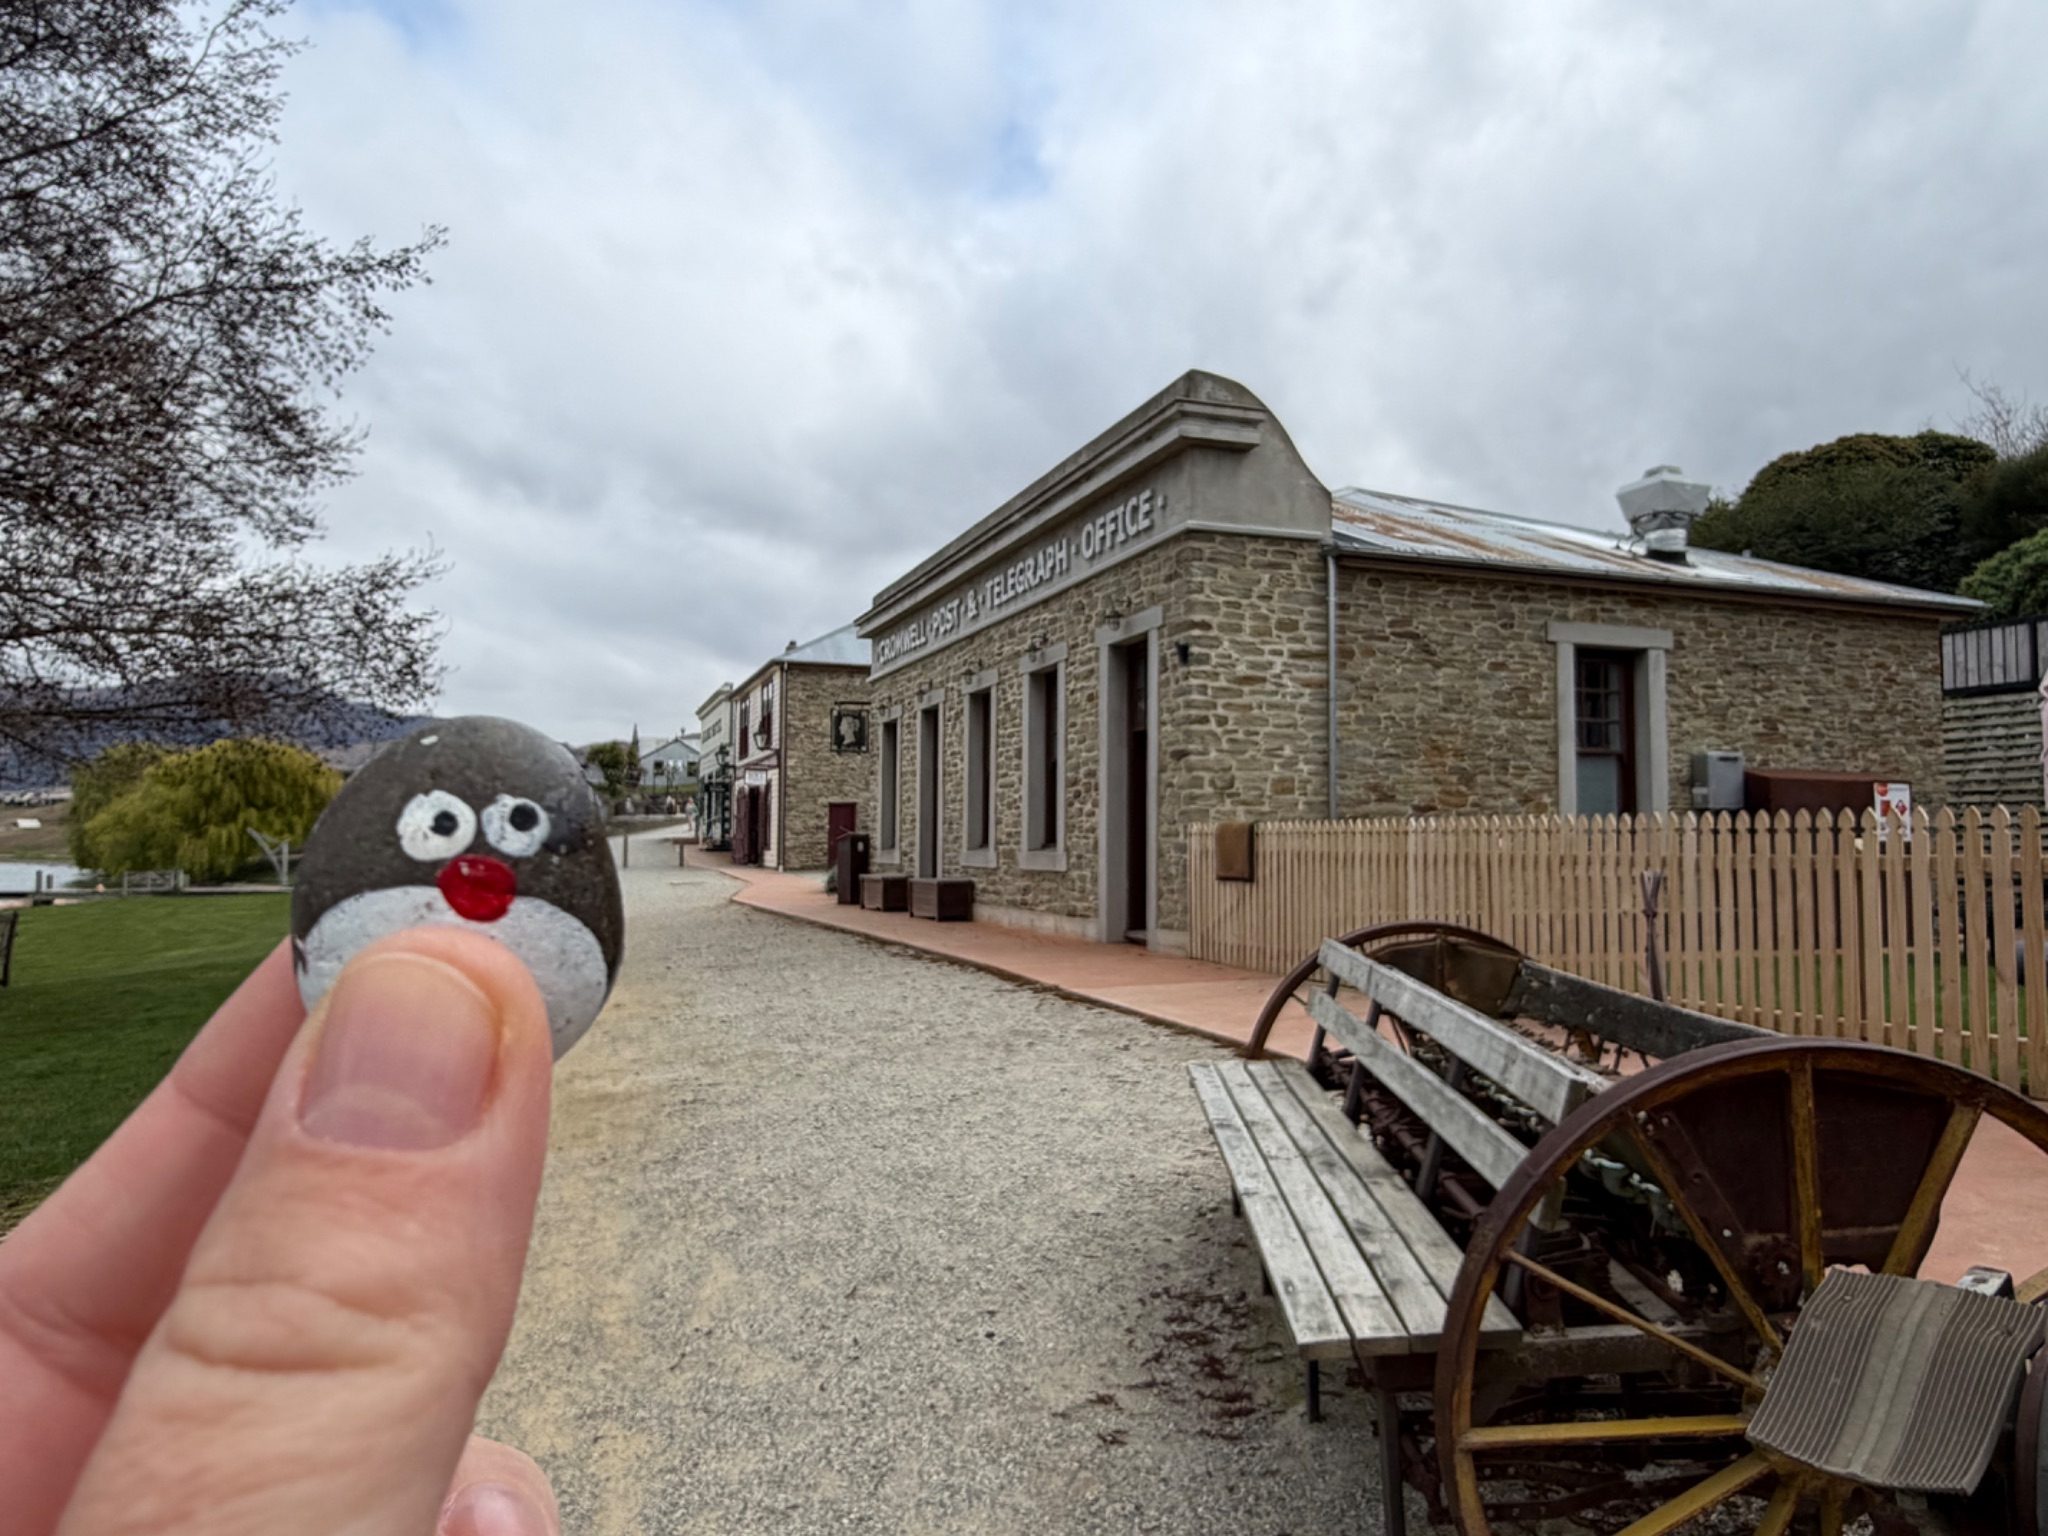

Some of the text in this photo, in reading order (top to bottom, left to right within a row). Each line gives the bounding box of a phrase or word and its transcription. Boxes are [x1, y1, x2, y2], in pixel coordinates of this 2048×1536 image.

[932, 598, 960, 638] POST
[967, 590, 979, 619] &
[985, 537, 1068, 609] TELEGRAPH
[1081, 489, 1152, 559] OFFICE
